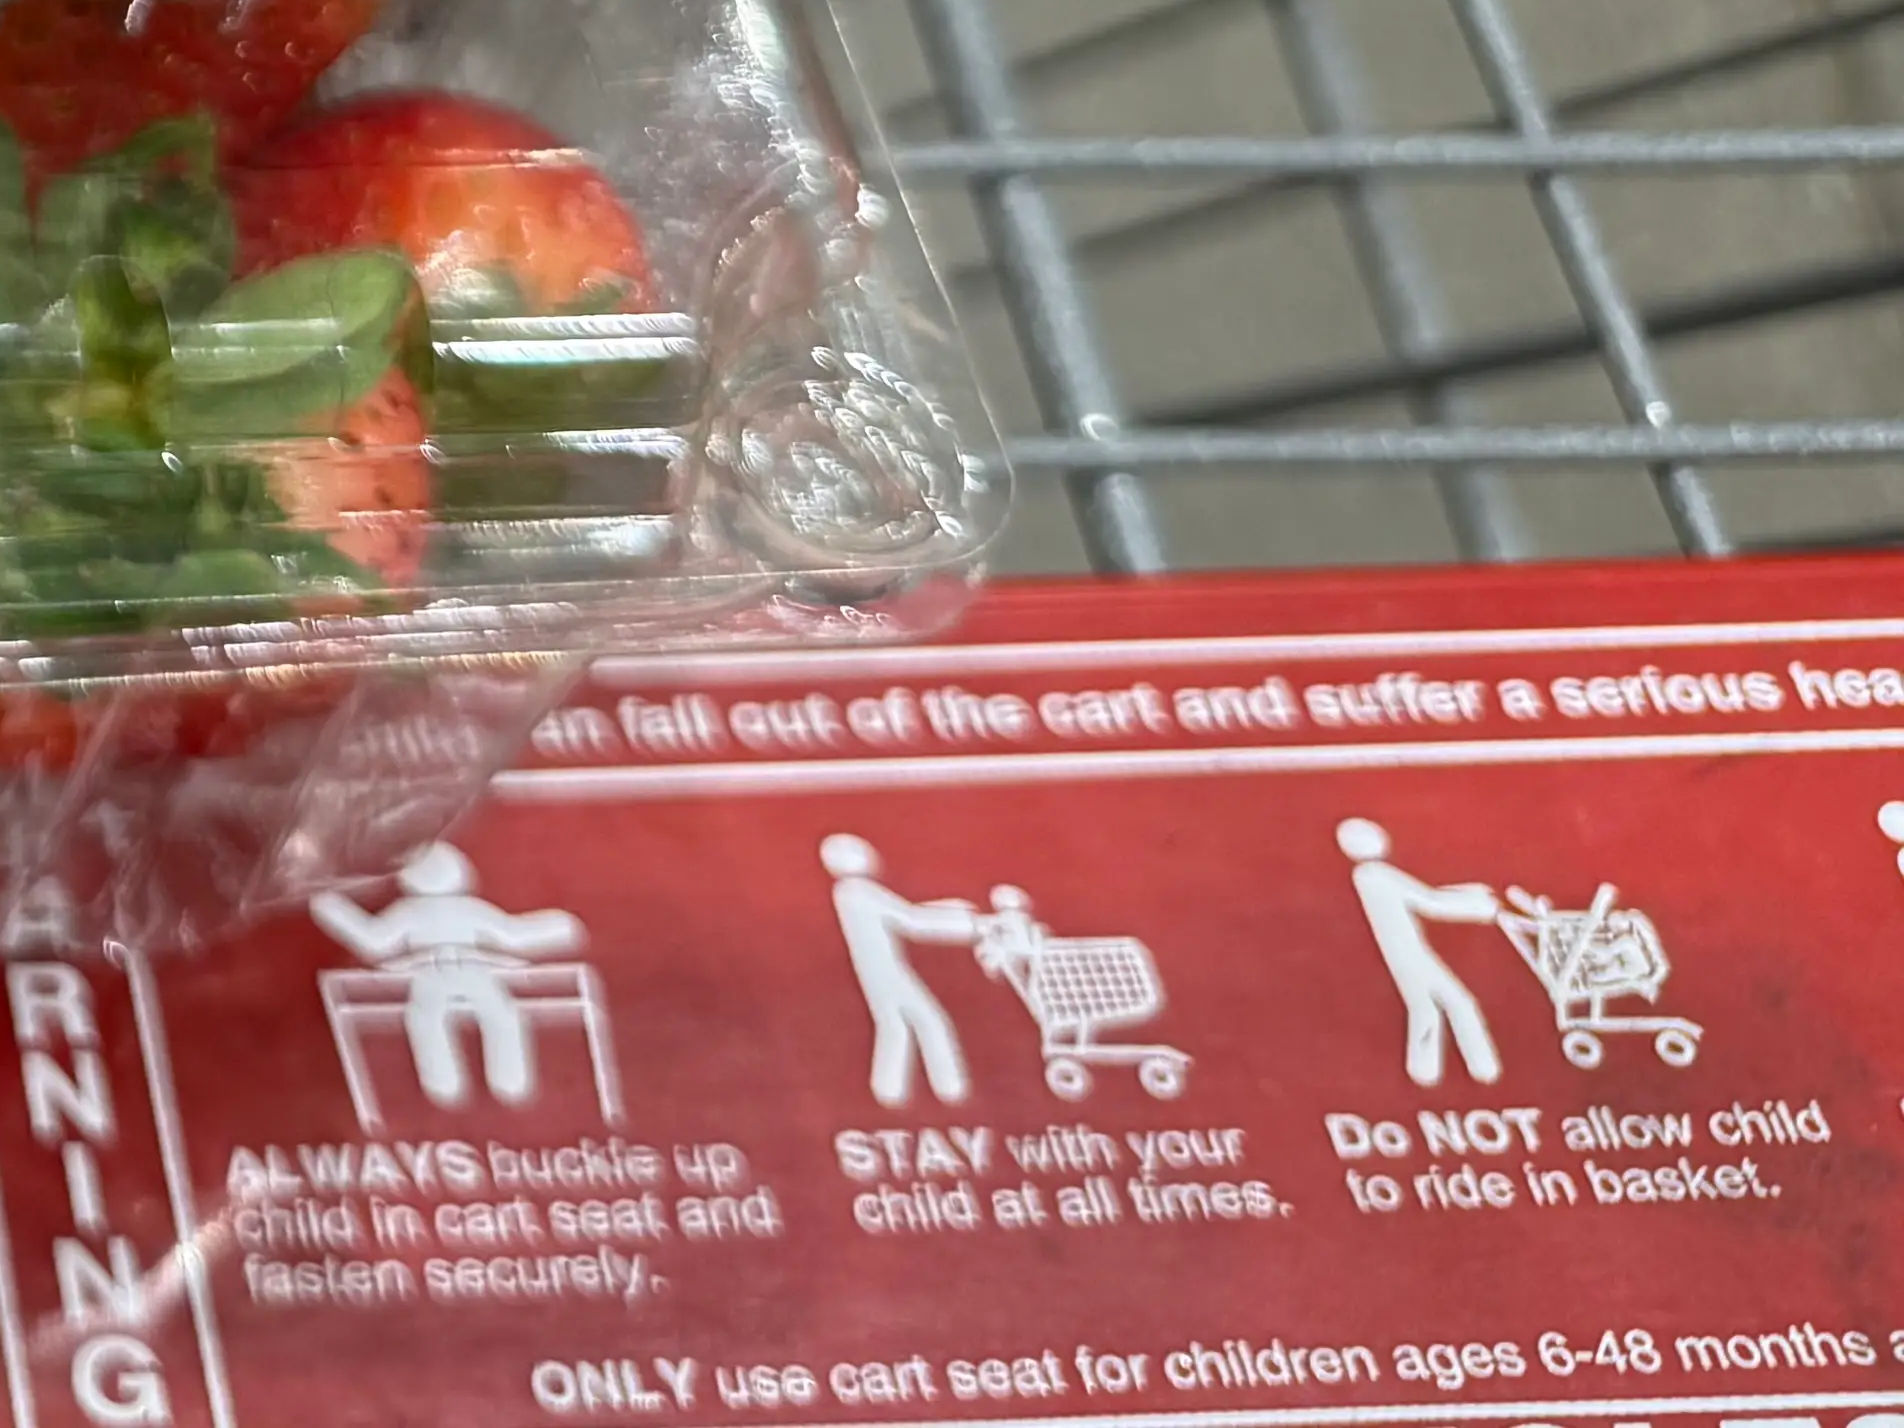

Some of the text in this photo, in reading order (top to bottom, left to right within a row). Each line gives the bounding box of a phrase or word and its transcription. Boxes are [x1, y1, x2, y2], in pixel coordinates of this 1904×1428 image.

[617, 692, 722, 758] fall
[727, 690, 844, 750] out
[846, 685, 921, 746] of
[922, 684, 1034, 744] the
[1037, 680, 1168, 740] cart
[1173, 675, 1298, 734] and
[1303, 671, 1486, 727] suffer
[1495, 676, 1543, 721] a
[1548, 664, 1785, 717] serious
[835, 1123, 1246, 1182] STAY with your
[1324, 1099, 1832, 1160] Do NOT allow child
[226, 1136, 752, 1196] ALWAYS buckle up
[1346, 1156, 1783, 1213] to ride in basket.
[230, 1185, 784, 1253] child in cart seat and
[853, 1175, 1296, 1235] child at all times.
[242, 1244, 671, 1311] fasten securely.
[531, 1356, 697, 1412] ONLY
[715, 1364, 819, 1411] use
[829, 1354, 938, 1405] cart
[947, 1348, 1068, 1401] seat
[1074, 1345, 1152, 1396] for
[1164, 1338, 1380, 1391] children
[1393, 1338, 1526, 1390] ages
[1538, 1327, 1662, 1376] 6-48
[1674, 1321, 1877, 1372] months
